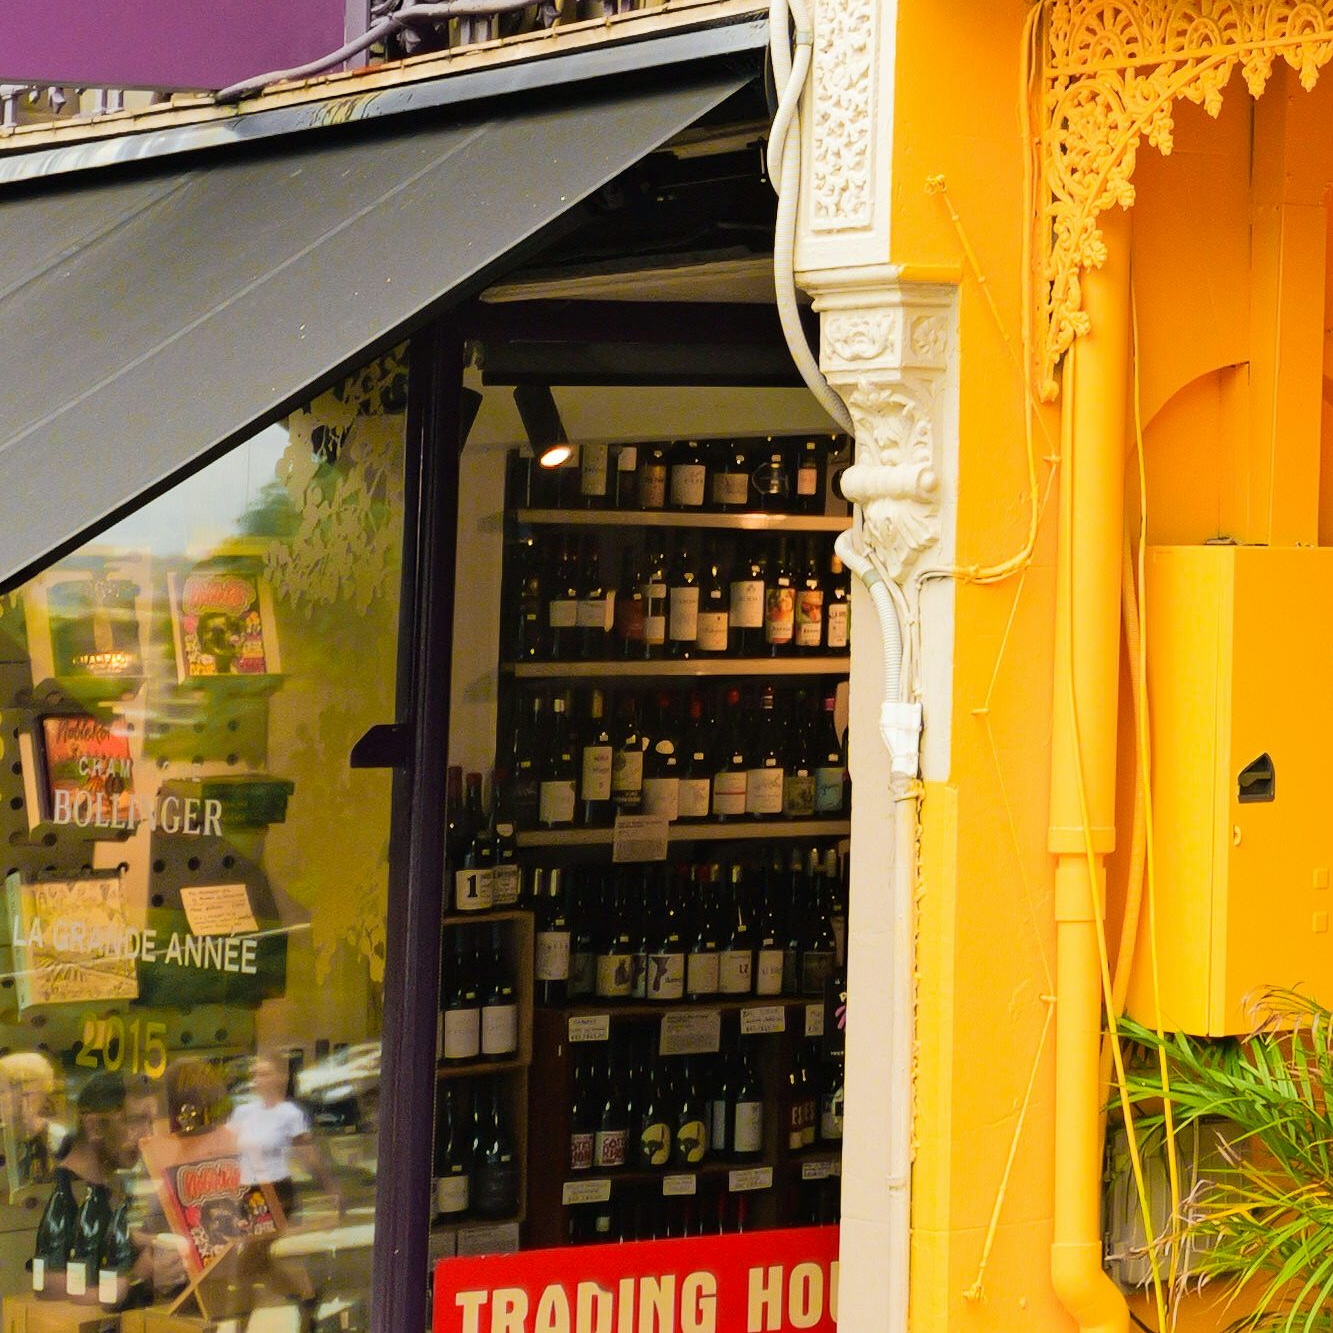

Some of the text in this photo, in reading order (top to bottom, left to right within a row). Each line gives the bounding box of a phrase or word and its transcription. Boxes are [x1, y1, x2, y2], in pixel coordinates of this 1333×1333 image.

[13, 914, 258, 975] LA GRANDE ANNÉE
[75, 1011, 167, 1078] 2015
[455, 1271, 716, 1333] TRADING
